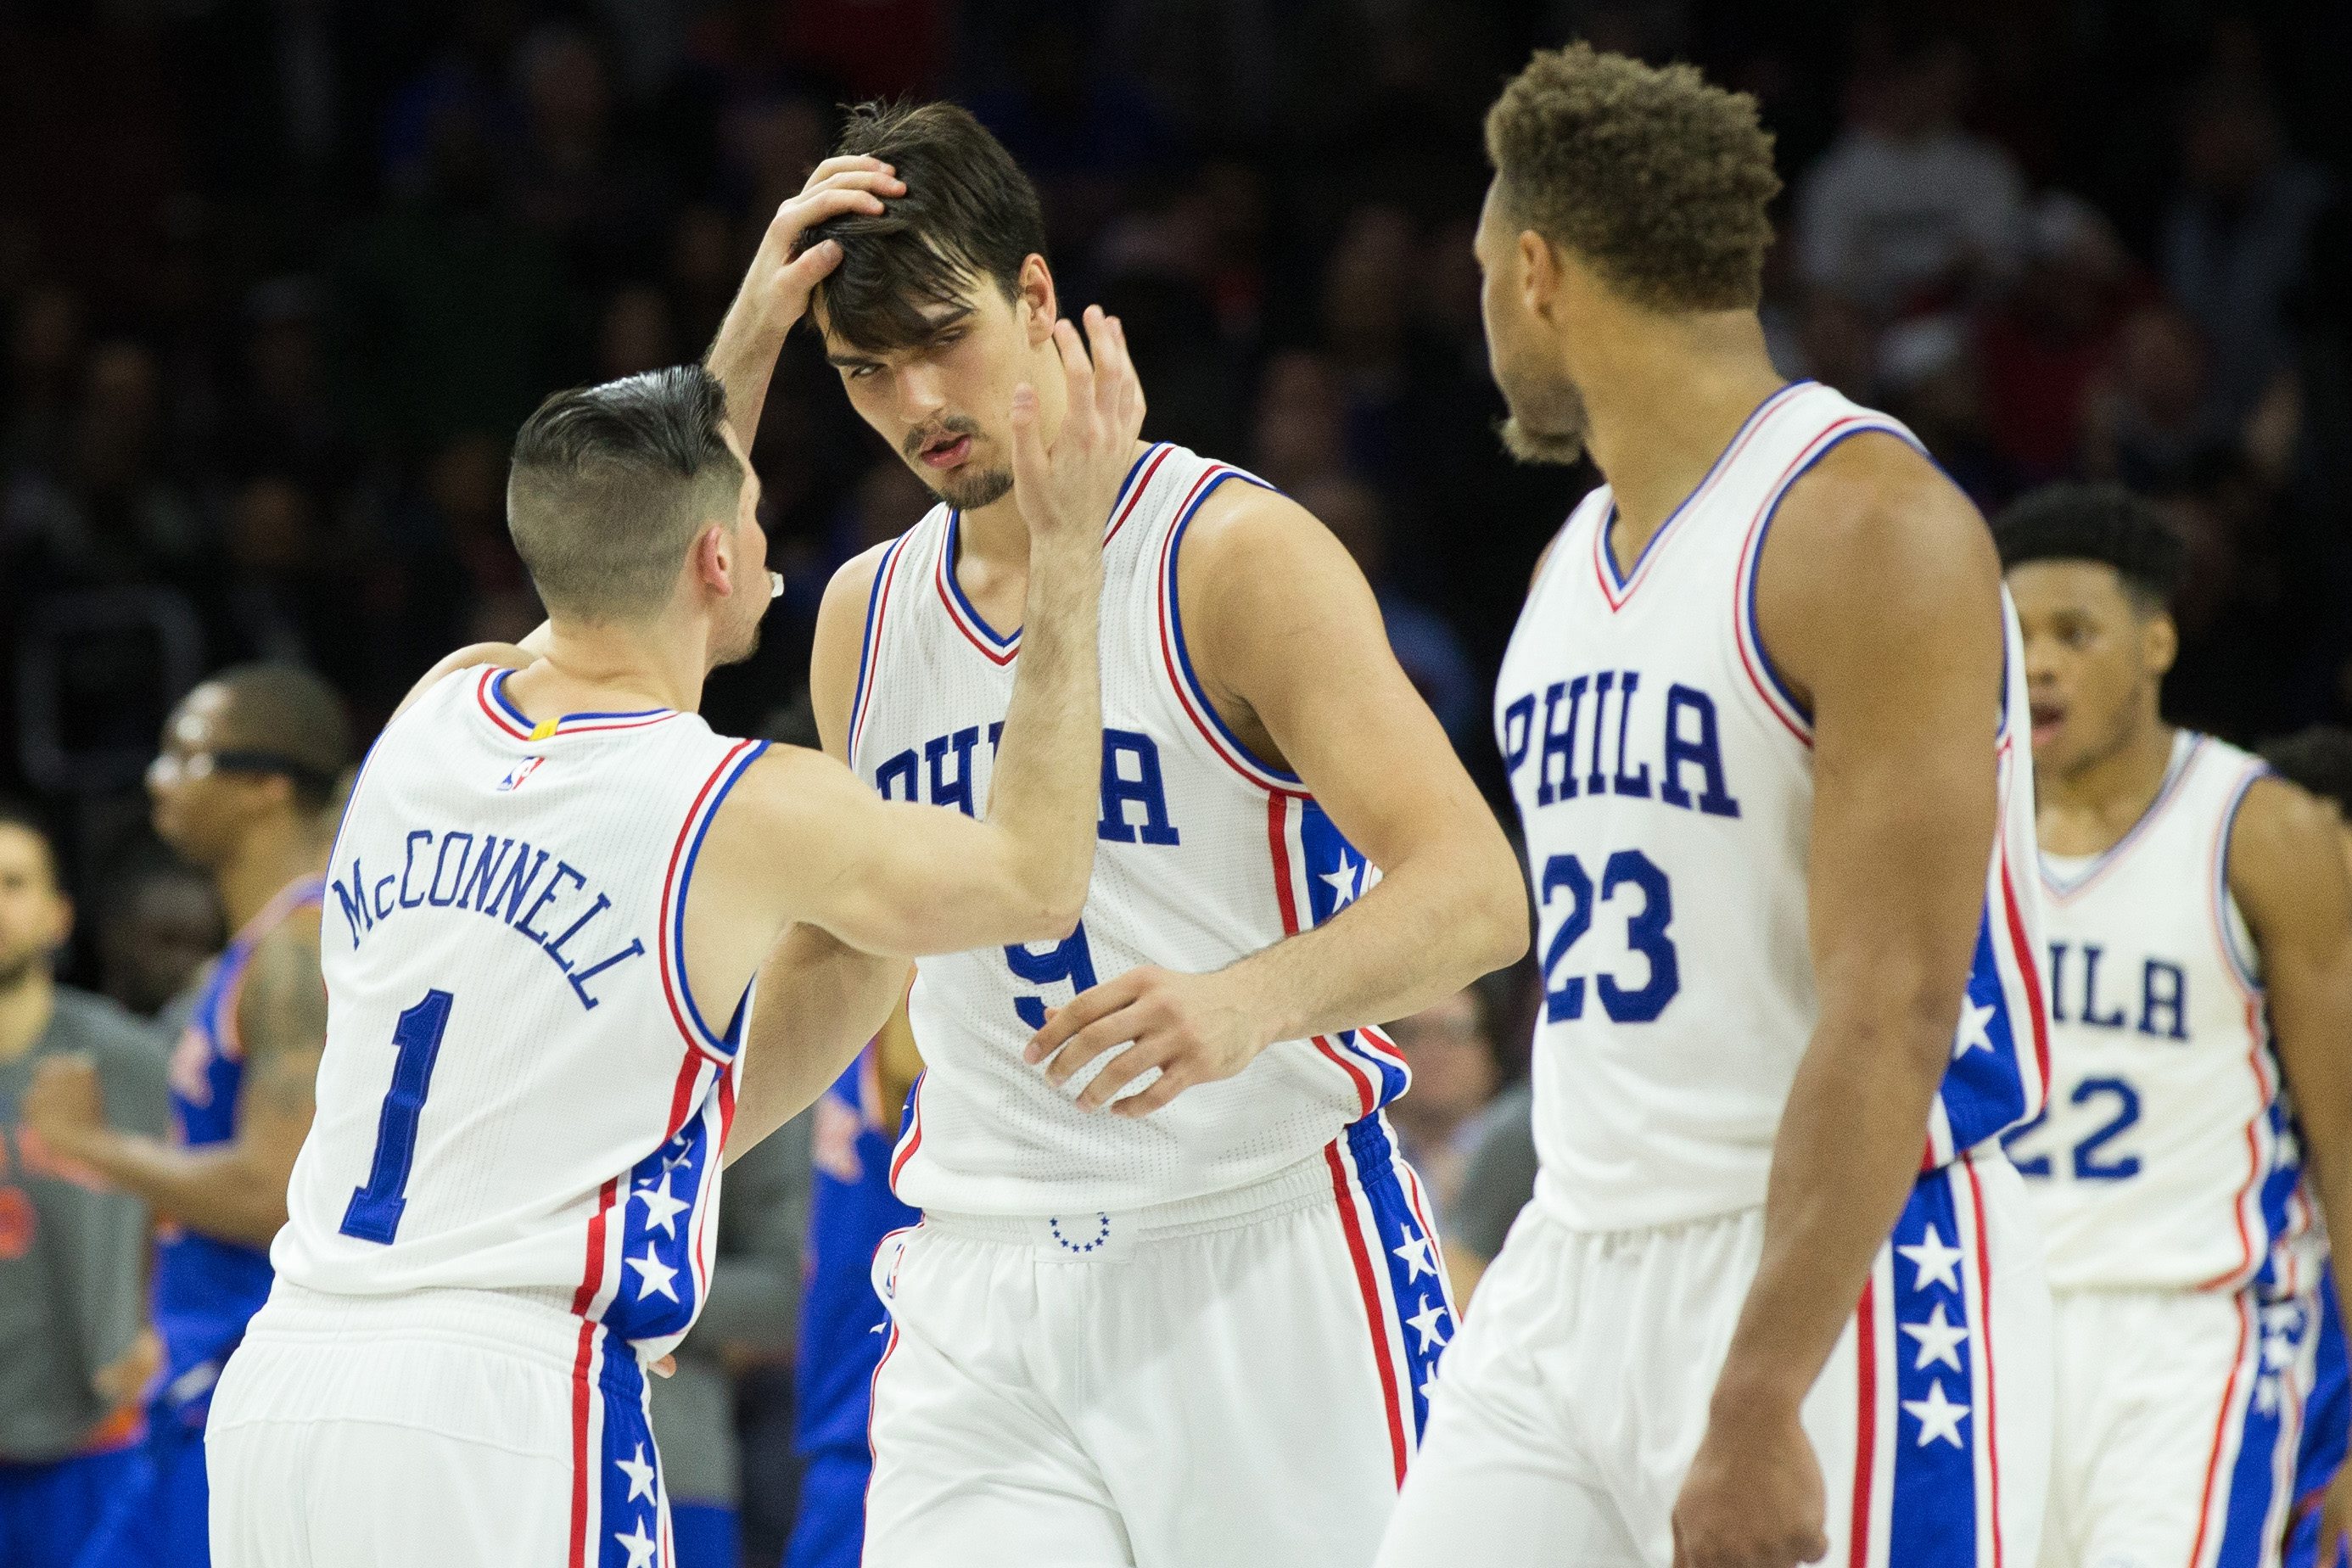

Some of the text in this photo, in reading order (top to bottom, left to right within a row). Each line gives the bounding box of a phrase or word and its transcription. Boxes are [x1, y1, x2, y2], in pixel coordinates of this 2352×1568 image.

[1505, 670, 1741, 819] PHILA
[332, 830, 645, 1011] McCONNELL
[1540, 849, 1680, 1023] 23
[339, 988, 455, 1246] 1
